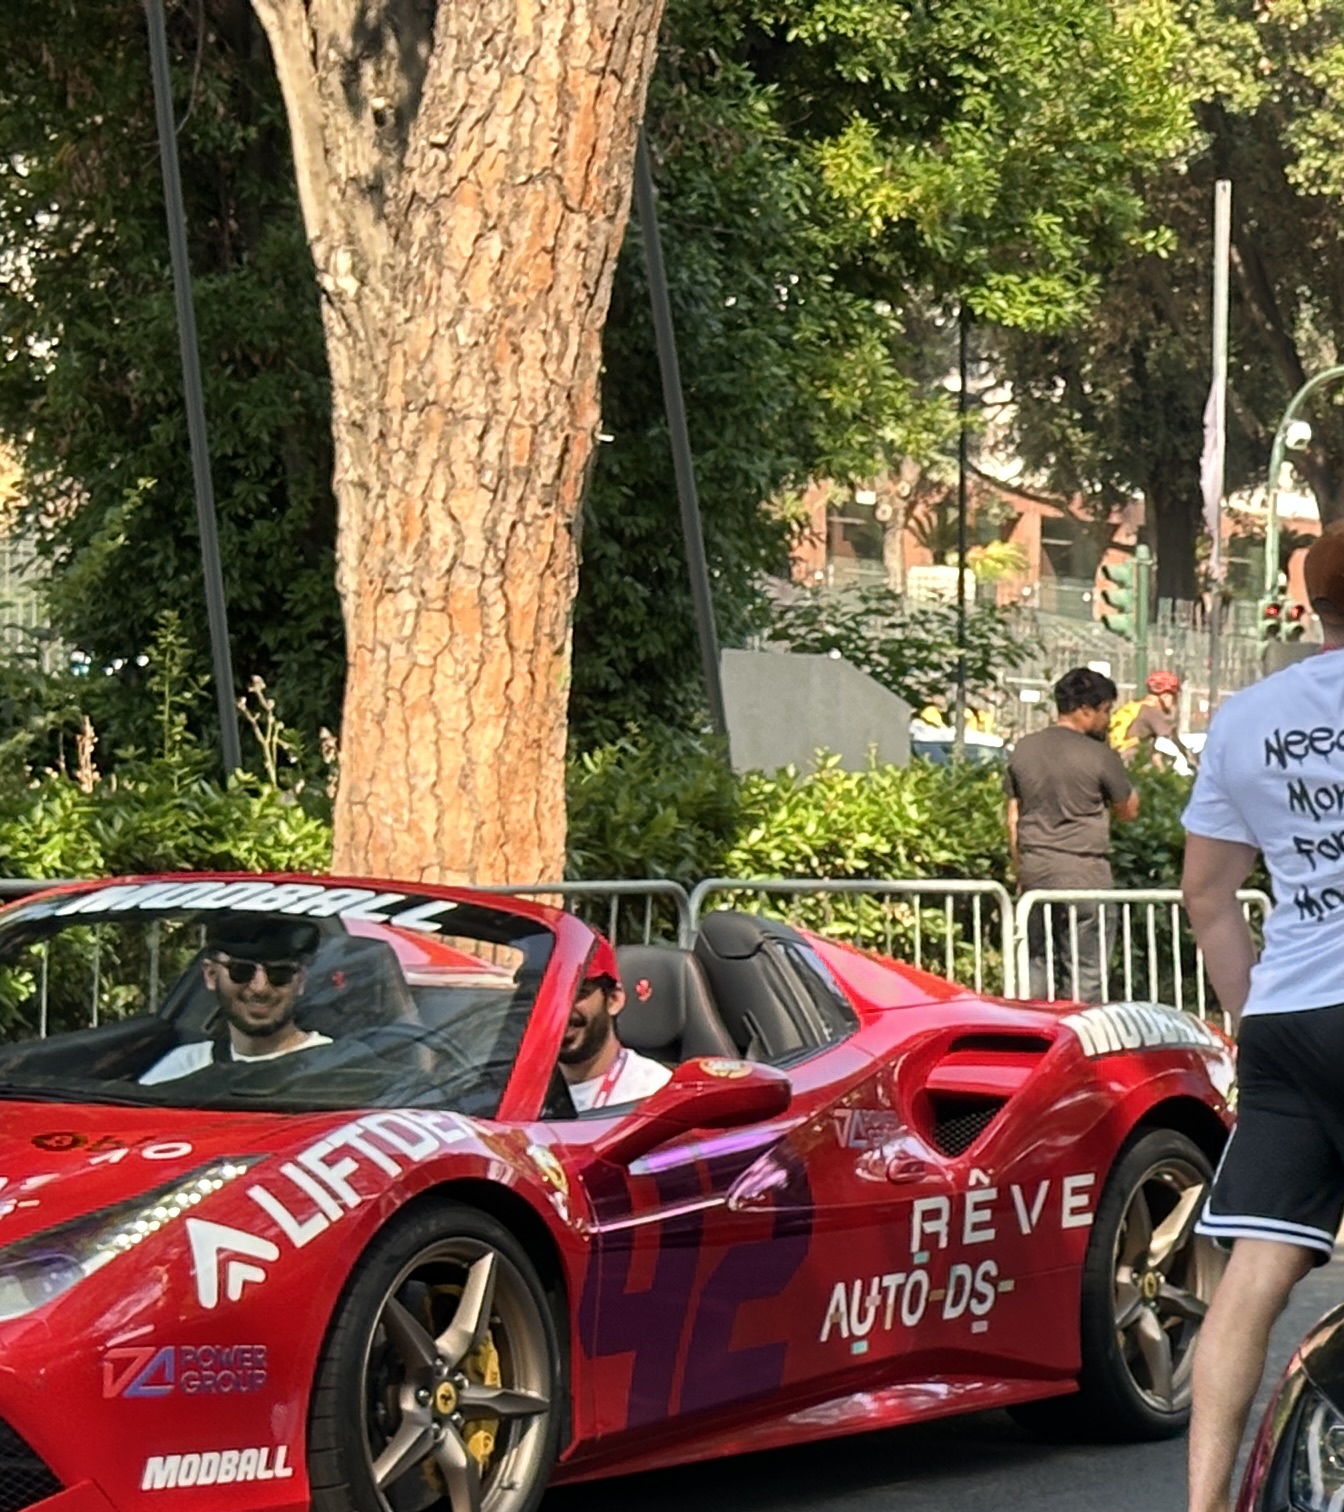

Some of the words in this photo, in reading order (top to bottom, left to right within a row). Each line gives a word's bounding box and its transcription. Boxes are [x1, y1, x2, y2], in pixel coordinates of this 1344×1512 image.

[55, 881, 458, 932] MODBALL
[910, 1167, 1096, 1253] RÊVE
[578, 1138, 815, 1428] 42
[181, 1345, 268, 1369] POWER
[181, 1370, 268, 1394] GROUP
[141, 1445, 293, 1491] MODBALL
